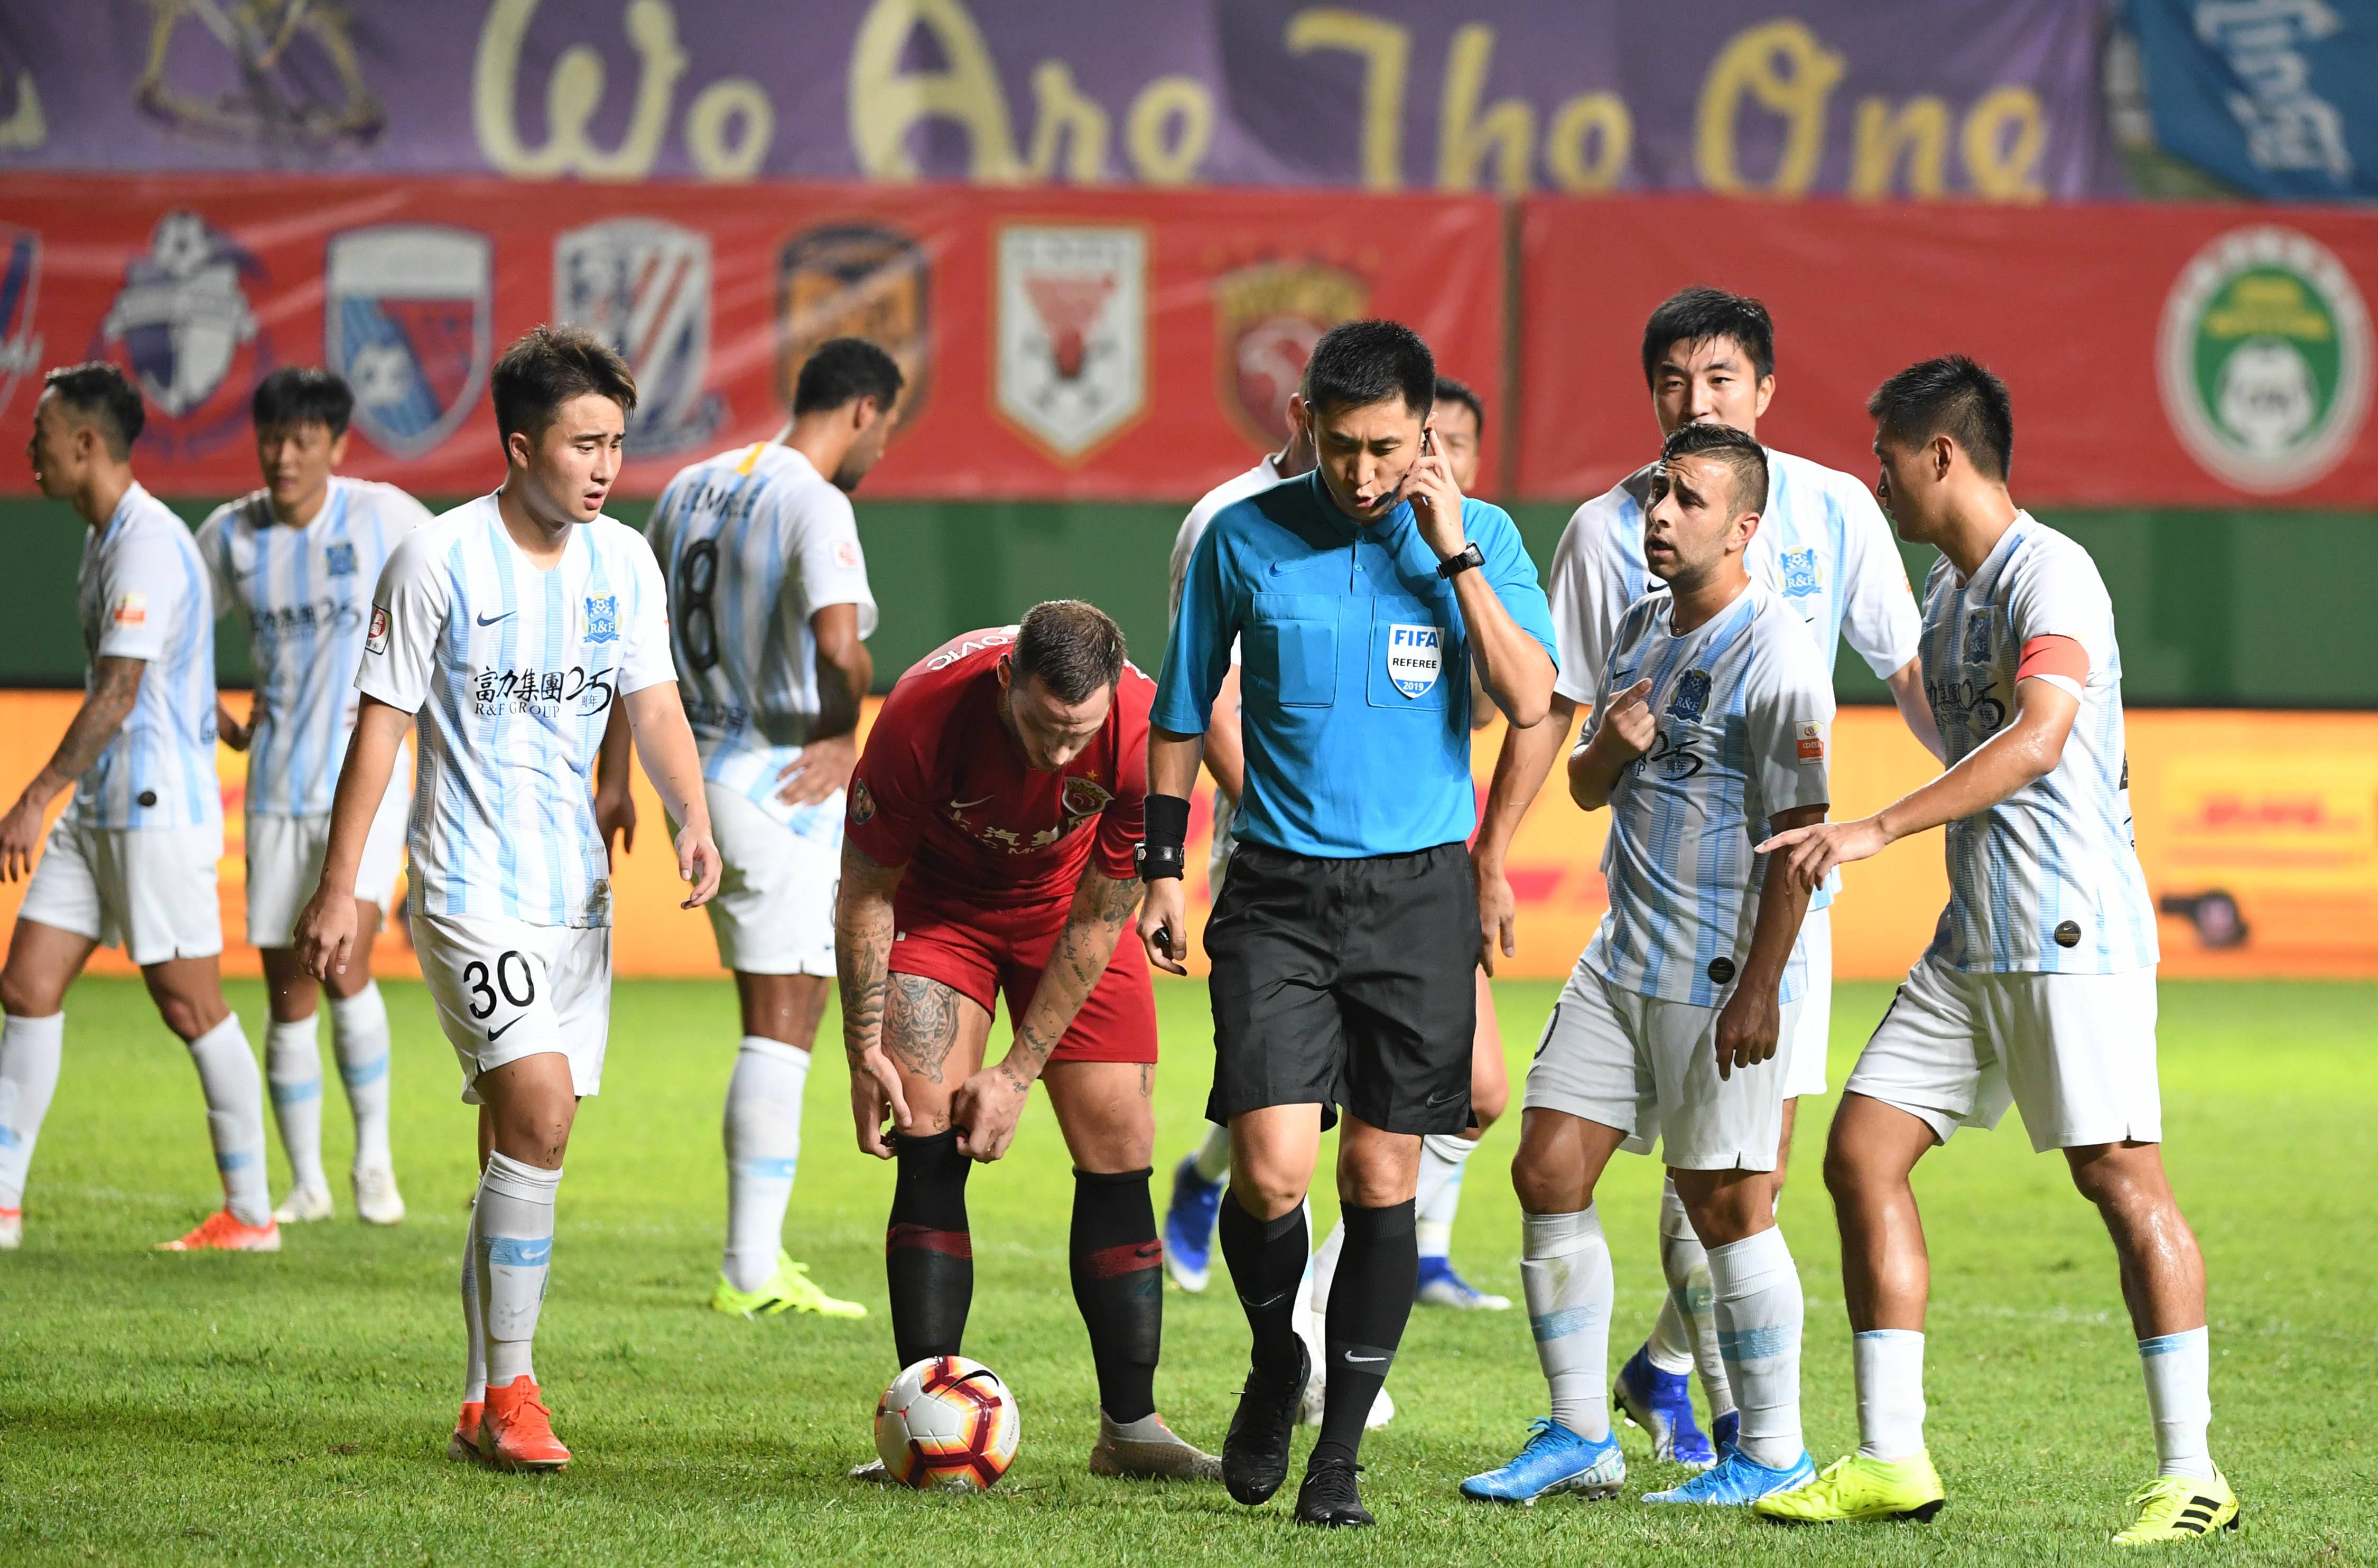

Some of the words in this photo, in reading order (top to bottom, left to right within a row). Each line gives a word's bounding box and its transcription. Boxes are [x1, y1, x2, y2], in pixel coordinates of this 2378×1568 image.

[1697, 19, 2048, 202] One
[1788, 574, 1815, 589] R&F
[681, 538, 720, 672] 8
[590, 621, 614, 633] R&F
[1395, 629, 1438, 648] FIFA
[1392, 658, 1437, 669] REFEREE
[473, 665, 565, 704] 富力集團
[565, 666, 615, 717] 25
[1403, 682, 1424, 690] 2019
[475, 702, 506, 716] R&F
[509, 702, 560, 718] GROUP
[1675, 697, 1699, 711] R&F
[1650, 730, 1703, 781] 25
[463, 950, 535, 1019] 30
